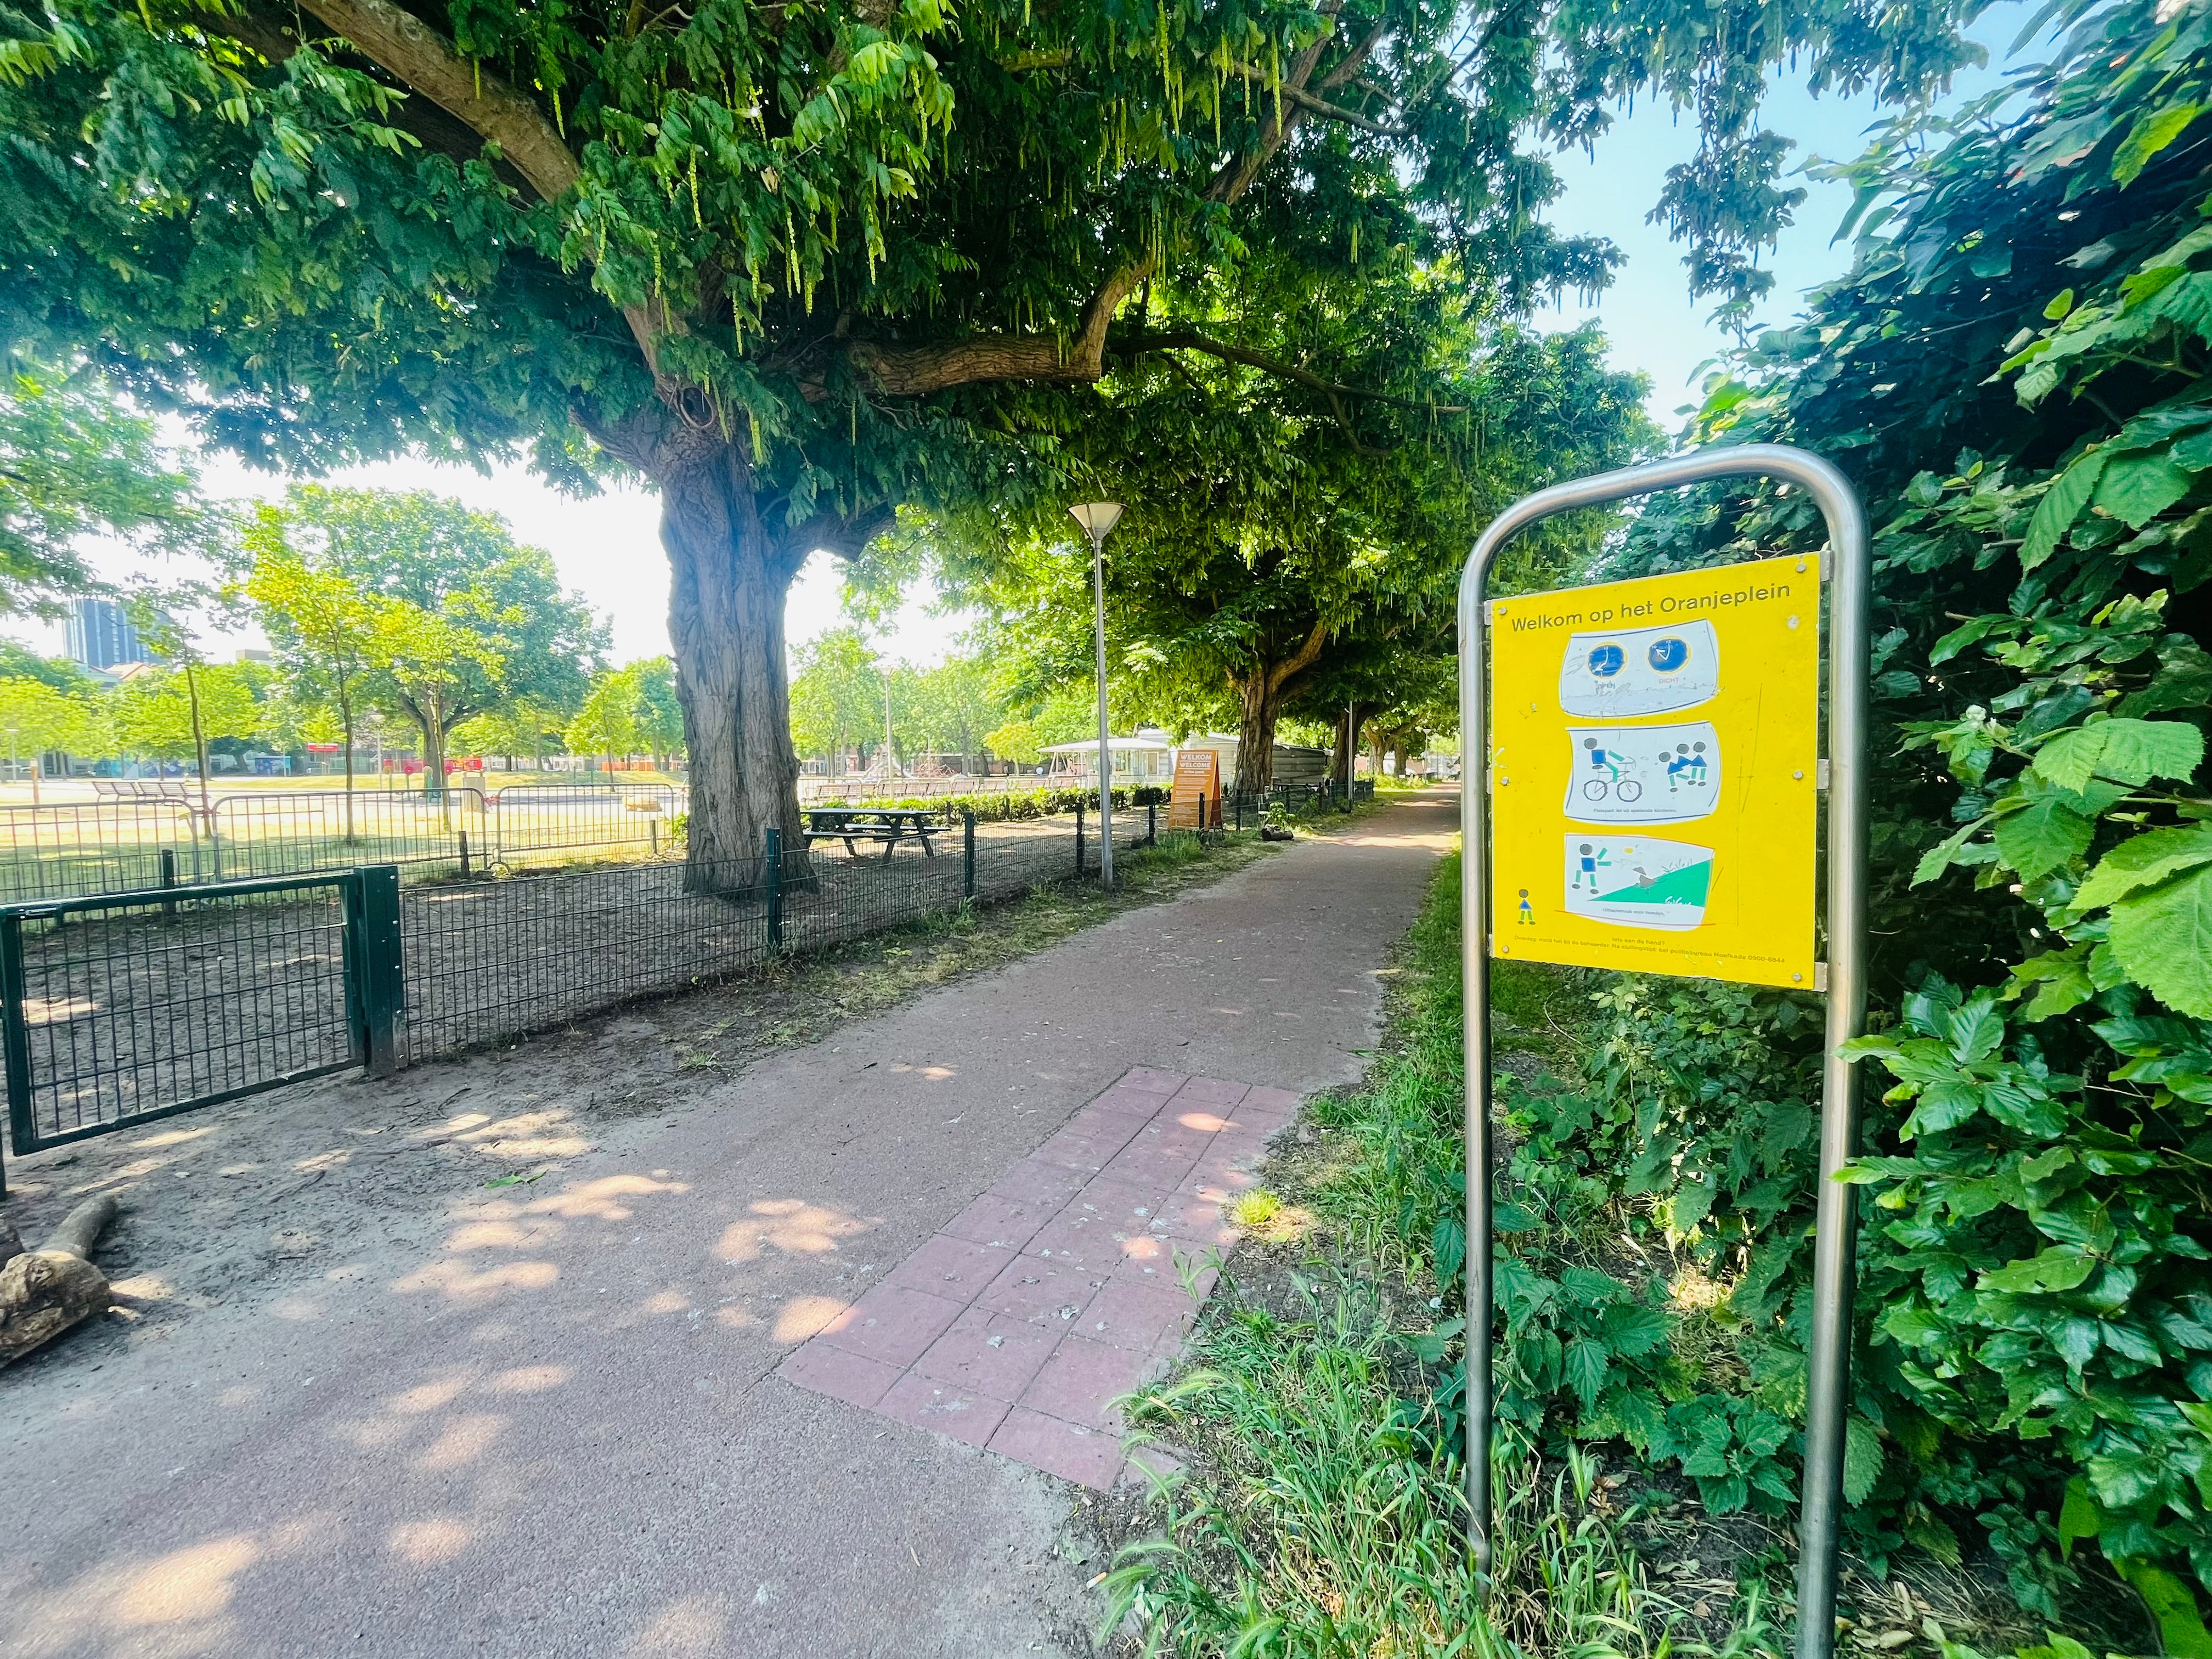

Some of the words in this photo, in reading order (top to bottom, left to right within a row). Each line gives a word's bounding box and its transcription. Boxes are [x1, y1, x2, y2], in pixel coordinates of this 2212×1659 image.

[1512, 613, 1582, 631] Welkom
[1589, 610, 1613, 623] op
[1621, 601, 1653, 618] het
[1660, 583, 1790, 613] Oranjeplein
